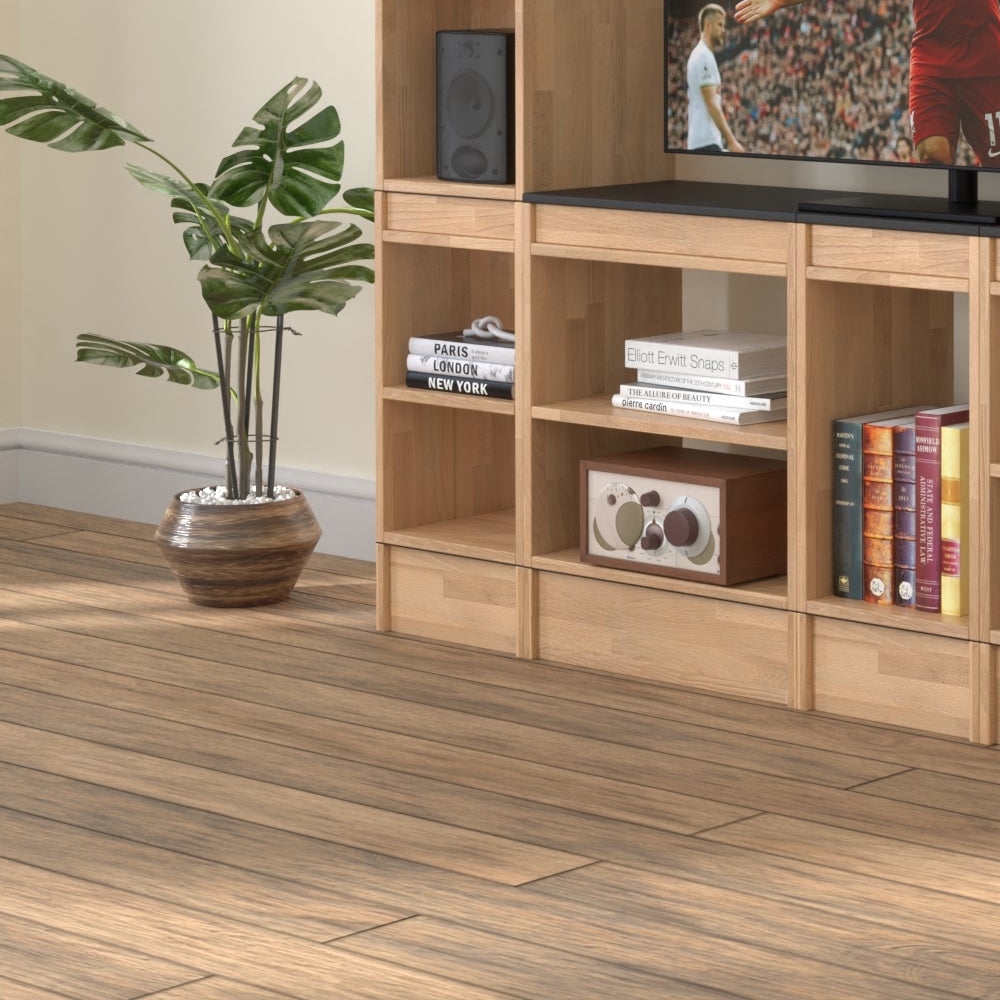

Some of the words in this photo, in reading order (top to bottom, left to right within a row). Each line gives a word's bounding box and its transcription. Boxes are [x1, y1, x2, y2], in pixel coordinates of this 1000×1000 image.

[434, 343, 468, 358] PARIS
[627, 347, 655, 364] Elliott
[657, 350, 687, 367] Erwitt
[690, 354, 725, 373] Snaps
[433, 360, 478, 376] LONDON
[428, 377, 454, 391] NEW
[456, 380, 488, 396] YORK
[628, 388, 643, 396] THE
[644, 389, 671, 399] ALLURE
[671, 392, 681, 400] OF
[682, 393, 712, 403] BEAUTY
[621, 397, 643, 409] pierre
[644, 402, 667, 412] cardin
[926, 478, 934, 504] STATE
[919, 476, 927, 543] ADMINISTRATIVE
[926, 506, 934, 524] AND
[926, 526, 934, 564] FEDERAL
[919, 546, 927, 565] LAW
